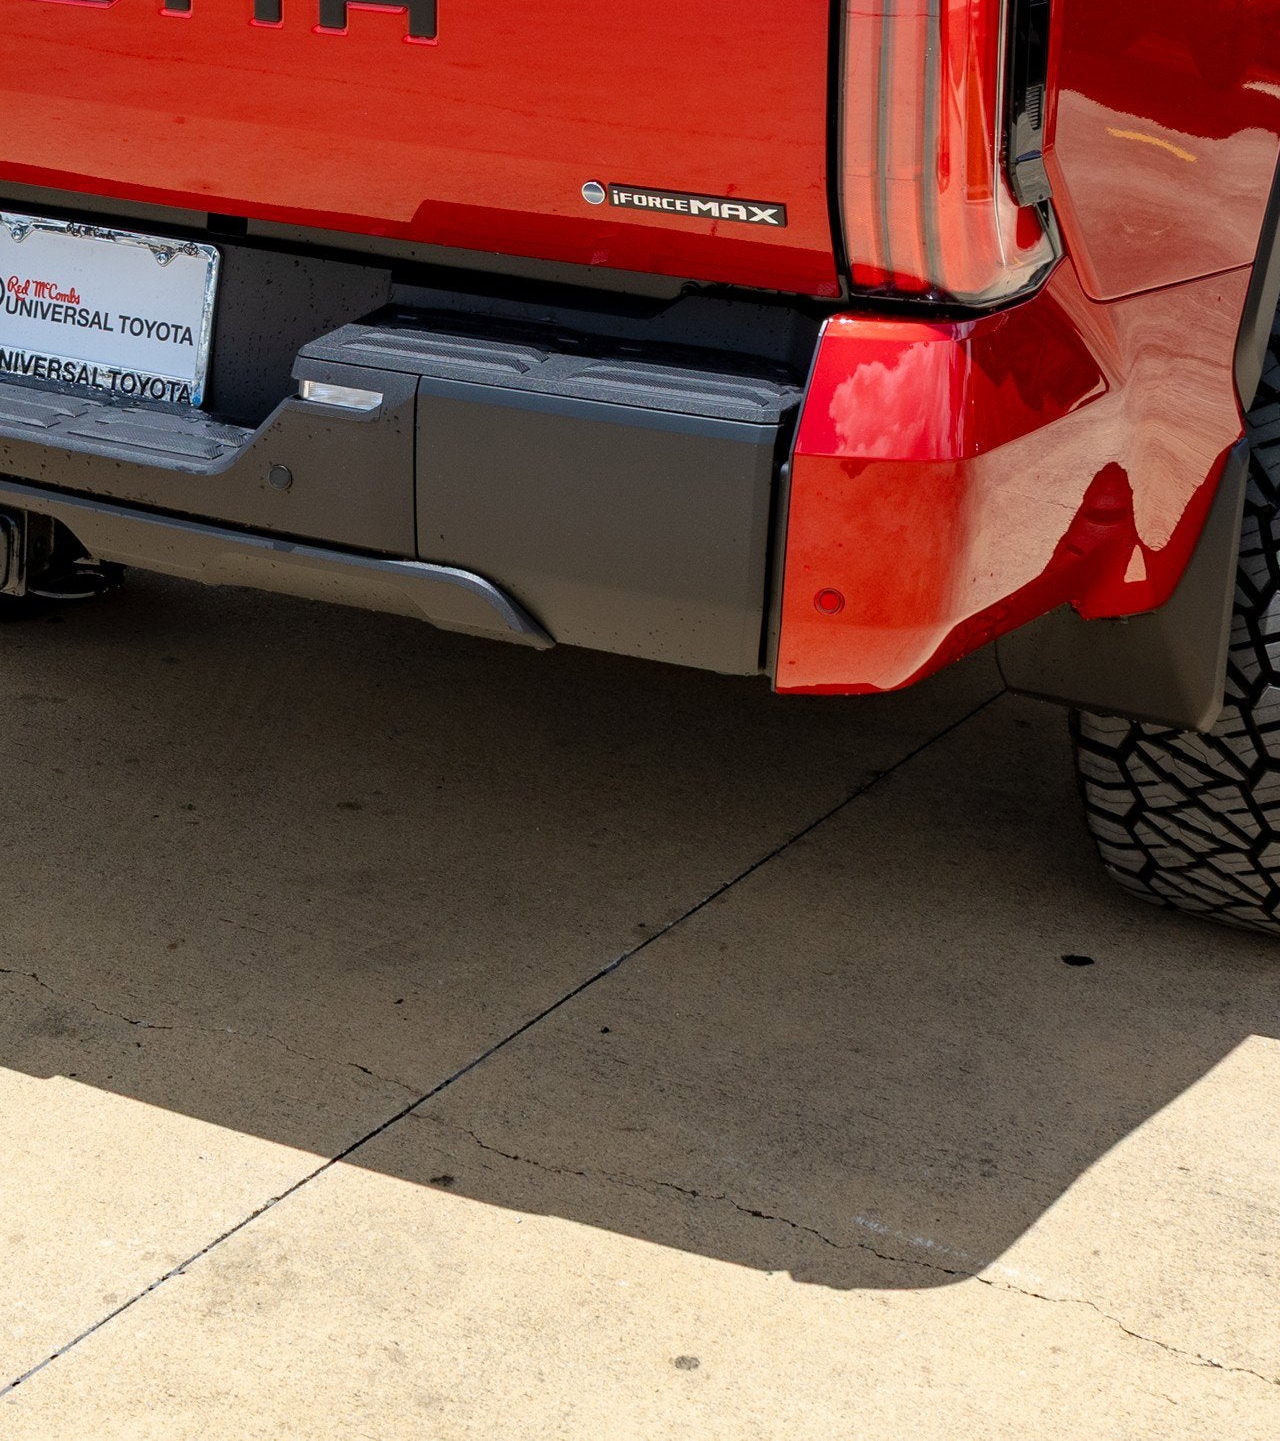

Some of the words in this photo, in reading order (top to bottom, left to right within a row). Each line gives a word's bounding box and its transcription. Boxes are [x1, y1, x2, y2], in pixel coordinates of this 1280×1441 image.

[7, 275, 29, 301] Red
[32, 280, 80, 306] McCombs
[5, 296, 114, 332] UNIVERSAL
[118, 315, 194, 346] TOYOTA
[106, 370, 192, 405] TOYOTA
